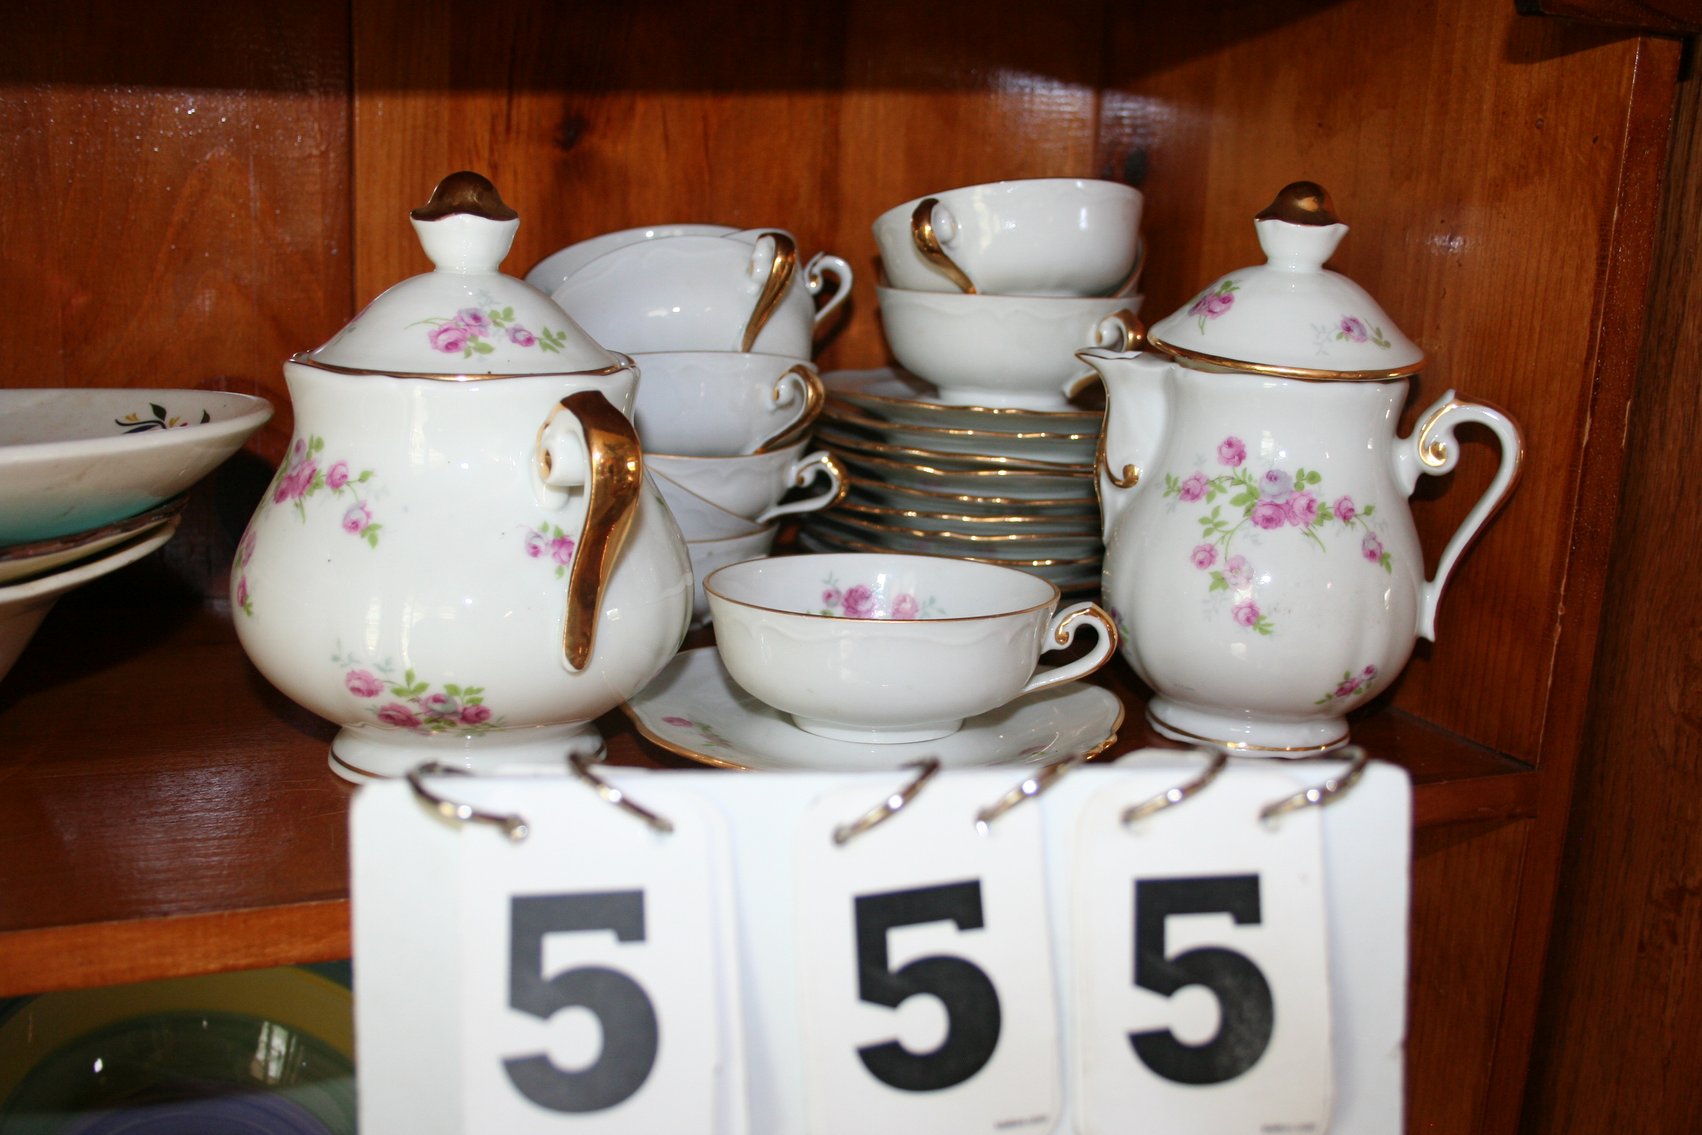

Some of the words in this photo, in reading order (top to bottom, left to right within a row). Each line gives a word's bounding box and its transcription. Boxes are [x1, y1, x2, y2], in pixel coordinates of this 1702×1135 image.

[502, 890, 660, 1114] 5
[853, 879, 1003, 1094] 5
[1127, 873, 1275, 1088] 5
